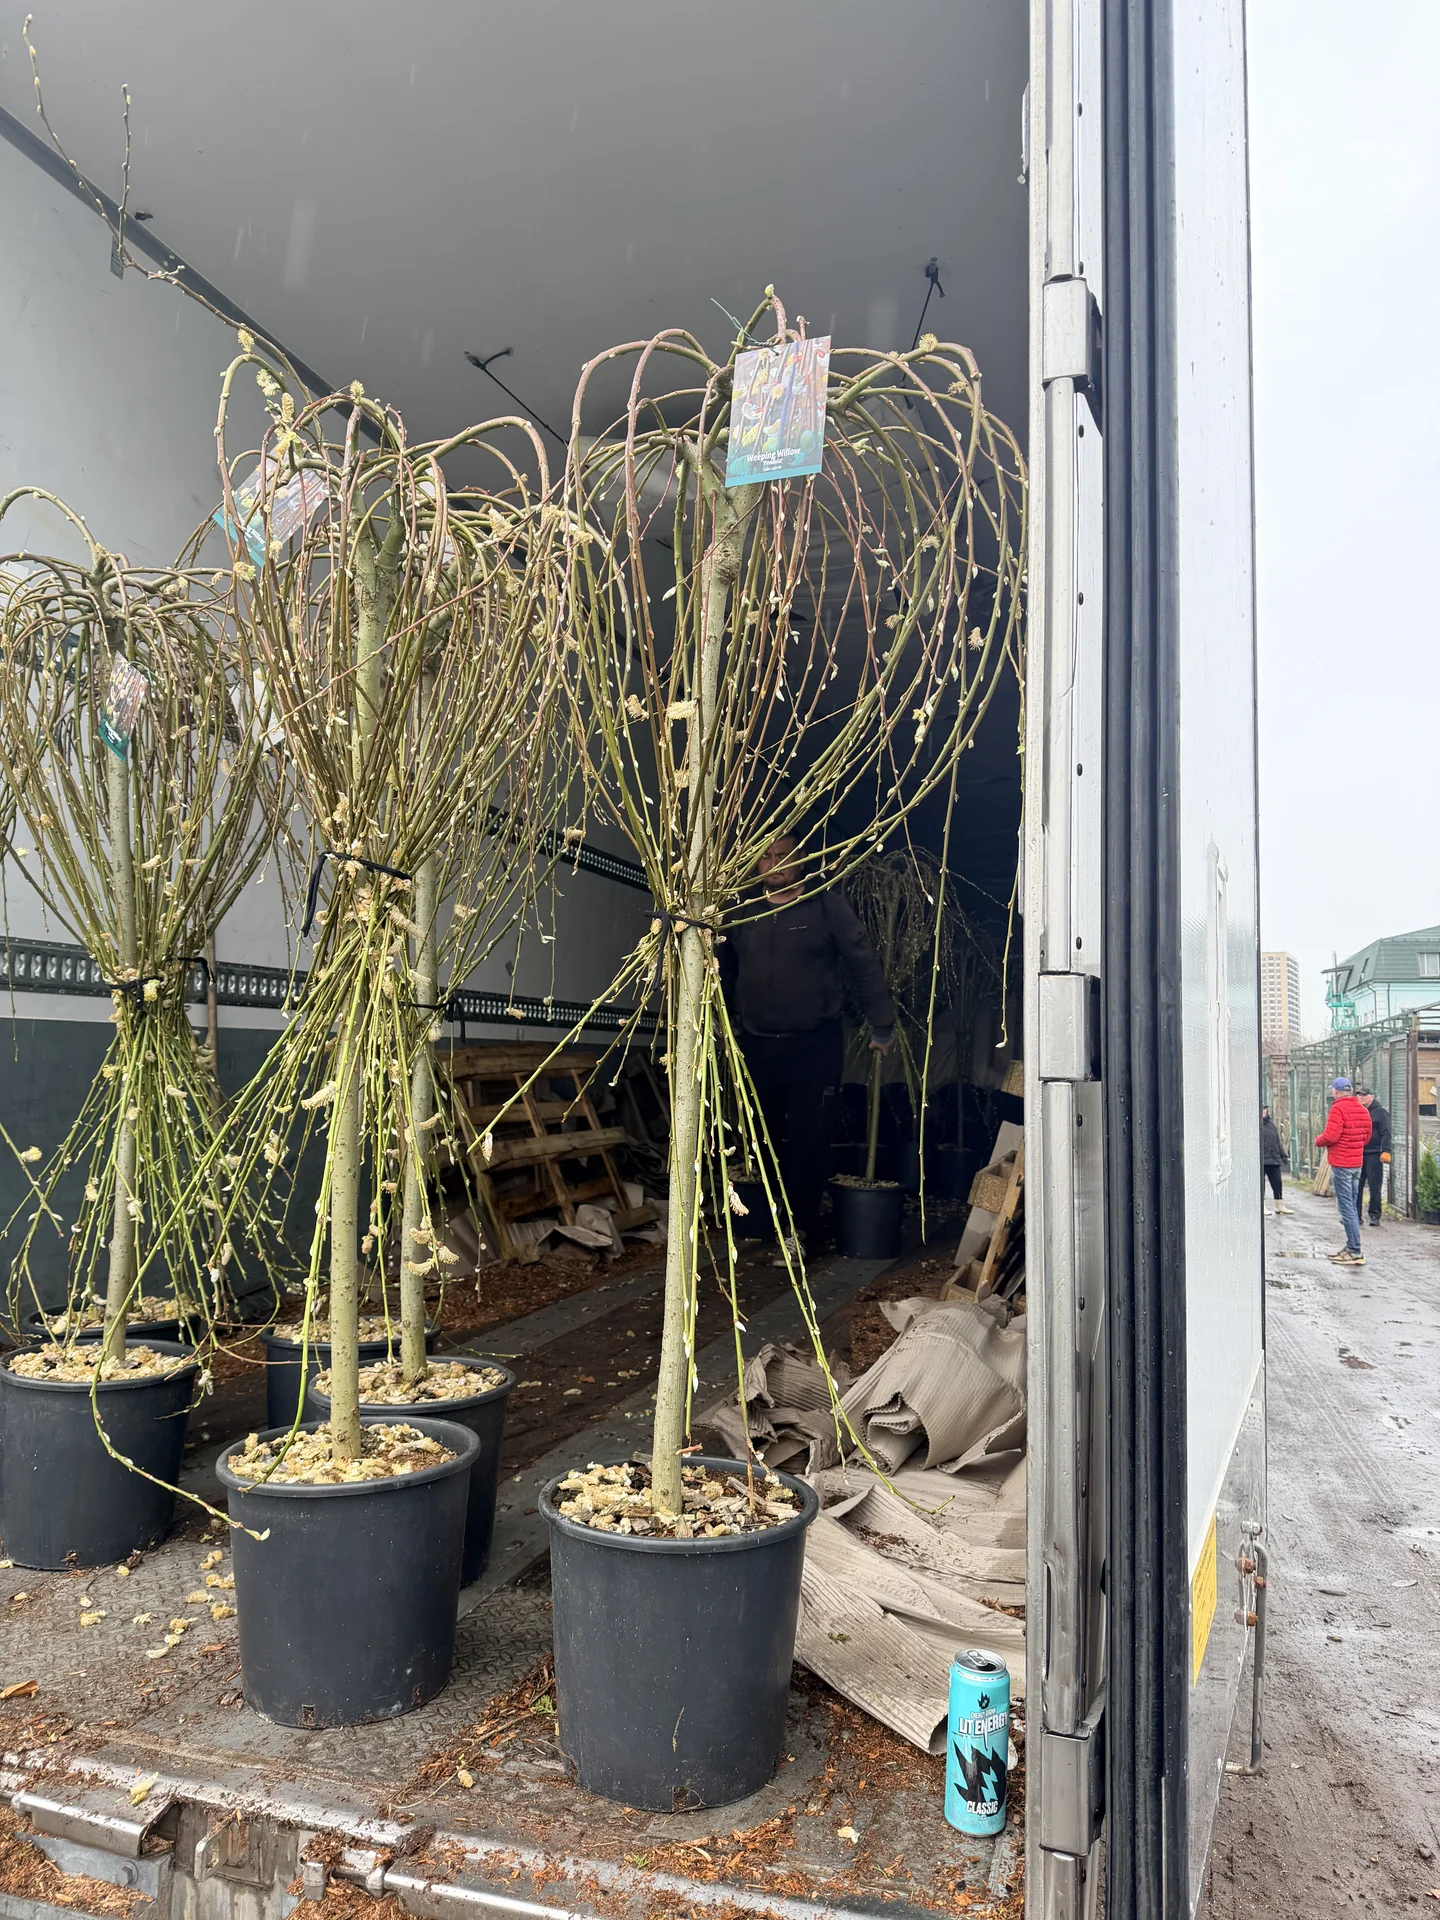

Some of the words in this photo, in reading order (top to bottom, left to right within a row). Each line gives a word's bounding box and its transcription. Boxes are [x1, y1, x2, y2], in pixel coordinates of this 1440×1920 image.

[746, 452, 777, 462] Weeping
[777, 448, 801, 458] Willow
[959, 1717, 975, 1735] LIT
[966, 1800, 999, 1815] CLASSIC
